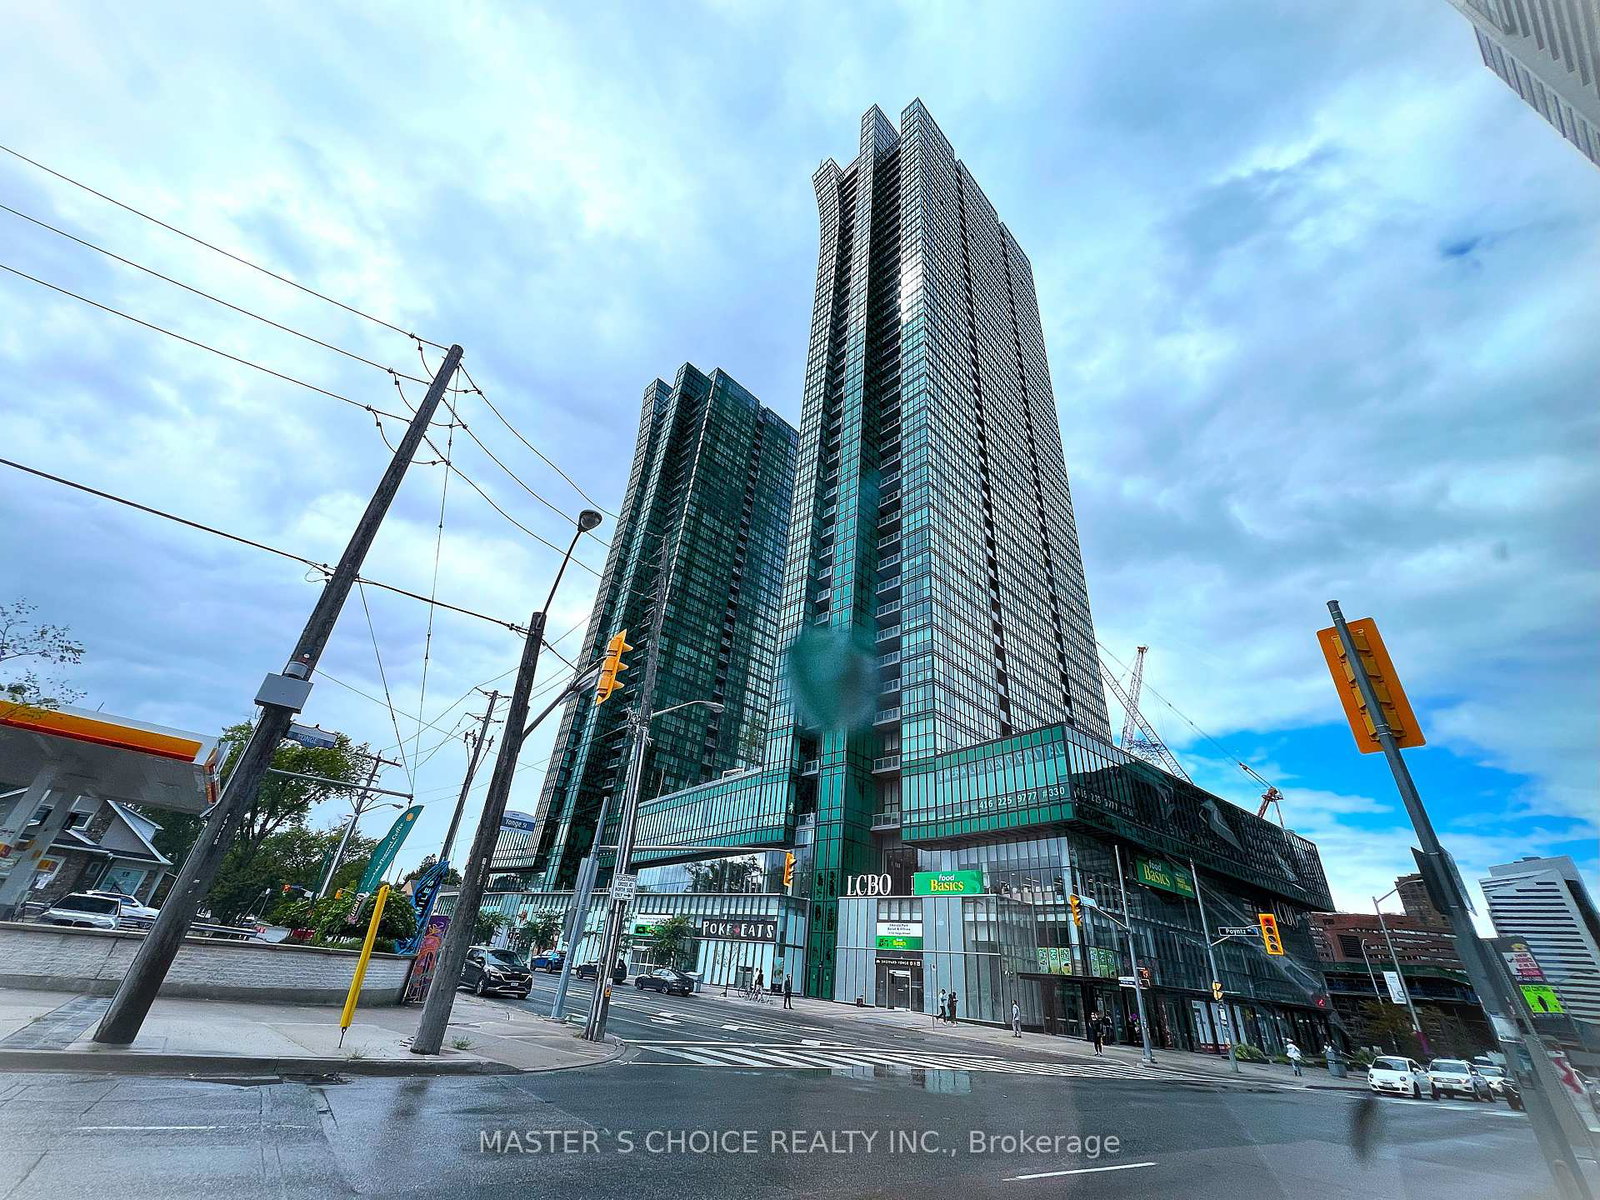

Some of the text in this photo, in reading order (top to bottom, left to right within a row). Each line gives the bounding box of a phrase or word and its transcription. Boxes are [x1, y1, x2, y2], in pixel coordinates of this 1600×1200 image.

[1017, 792, 1037, 802] 9777
[938, 873, 955, 881] food
[846, 873, 892, 896] LCBO
[930, 879, 964, 892] Basics
[702, 921, 774, 938] POKE EATS
